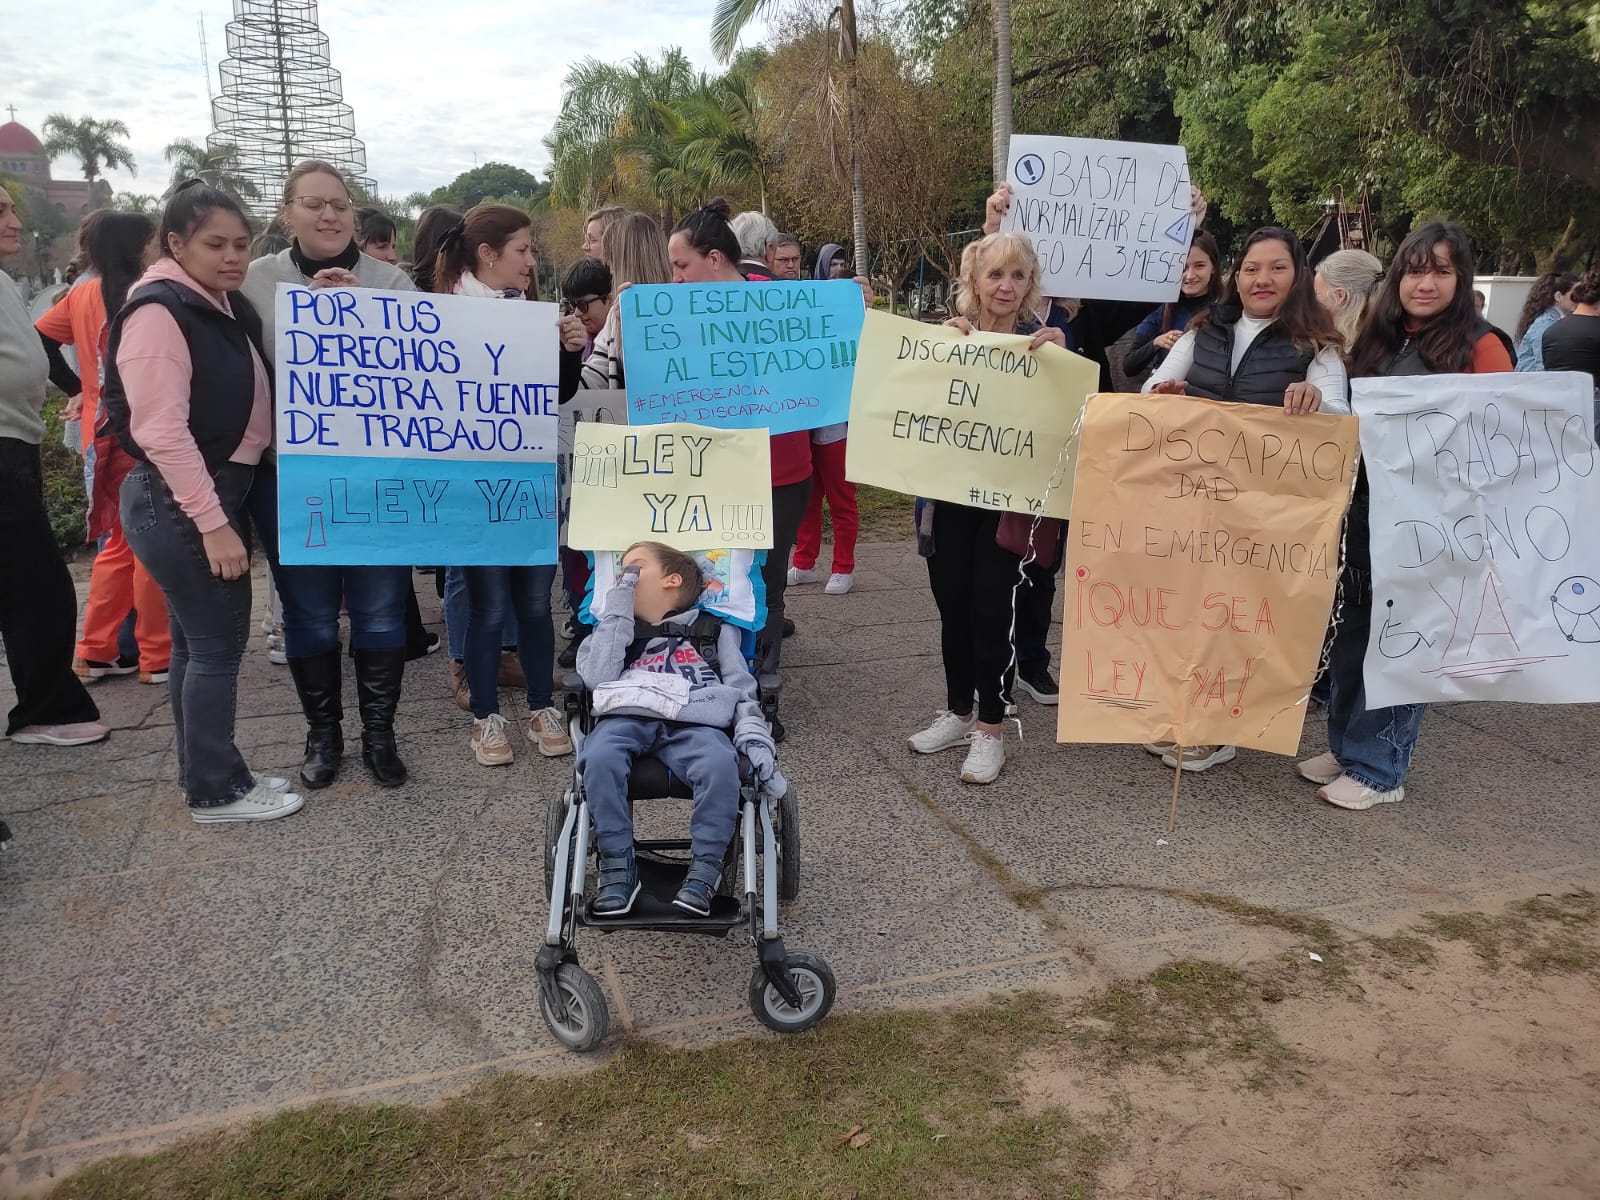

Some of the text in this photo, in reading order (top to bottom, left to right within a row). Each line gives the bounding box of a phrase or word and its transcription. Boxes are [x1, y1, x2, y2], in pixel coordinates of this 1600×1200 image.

[1049, 150, 1192, 211] BASTA DE
[1136, 211, 1160, 243] EL
[1075, 243, 1093, 279] A
[1104, 245, 1128, 277] 3
[1127, 248, 1188, 284] MESES
[286, 289, 441, 334] POR TUS
[634, 287, 825, 318] LO ESENCIAL
[284, 329, 506, 376] DERECHOS Y
[644, 314, 838, 351] ES INVISIBLE
[664, 356, 699, 384] AL
[896, 335, 1039, 378] DISCAPACIDAD
[288, 369, 444, 412] NUESTRA
[455, 379, 560, 417] FUENTE
[633, 383, 771, 412] #EMERGENCIA
[697, 396, 820, 420] DISCAPACIDAD
[947, 378, 981, 408] EN
[283, 409, 340, 447] DE
[355, 412, 544, 452] TRABAJO...
[891, 409, 1035, 459] EMERGENCIA
[1374, 402, 1594, 494] TRABAJO
[968, 486, 1014, 508] #LEY
[1164, 472, 1239, 502] DAD
[305, 473, 557, 548] ¡LEY YA!
[642, 492, 713, 533] YA
[1080, 519, 1330, 580] EN EMERGENCIA
[1394, 505, 1571, 569] DIGNO
[1075, 565, 1275, 637] ¡QUE SEA
[1428, 571, 1520, 660] YA
[1086, 650, 1257, 719] LEY YA!
